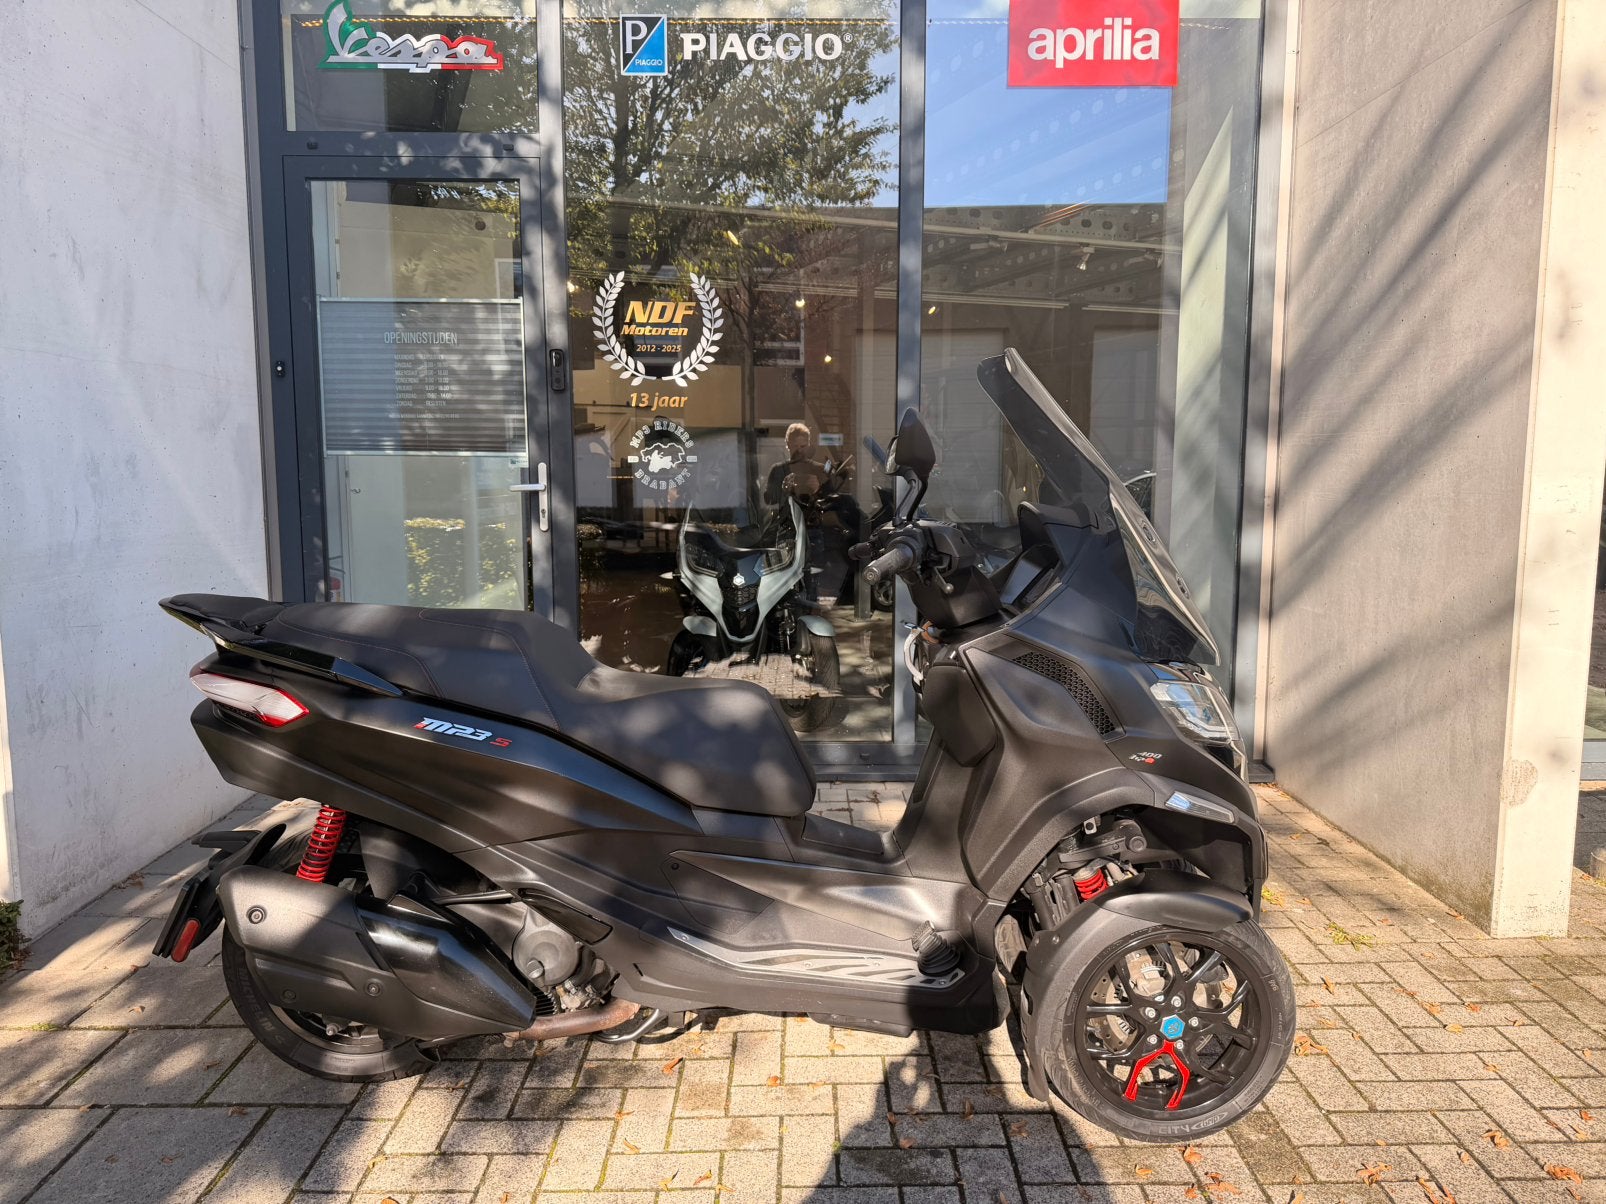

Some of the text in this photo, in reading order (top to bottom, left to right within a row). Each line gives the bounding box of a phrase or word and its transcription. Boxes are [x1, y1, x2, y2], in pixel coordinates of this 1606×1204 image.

[326, 2, 499, 69] Vespa
[1027, 17, 1160, 69] aprilia
[635, 58, 663, 66] PIAGGIO
[624, 301, 696, 324] NDF
[621, 324, 689, 336] Motoren
[636, 344, 656, 352] 2012
[662, 344, 682, 352] 2025
[630, 392, 688, 411] 13 jaar
[629, 420, 694, 448] MP3 RIDERS
[634, 468, 691, 490] BRABANT
[413, 717, 493, 741] MP3
